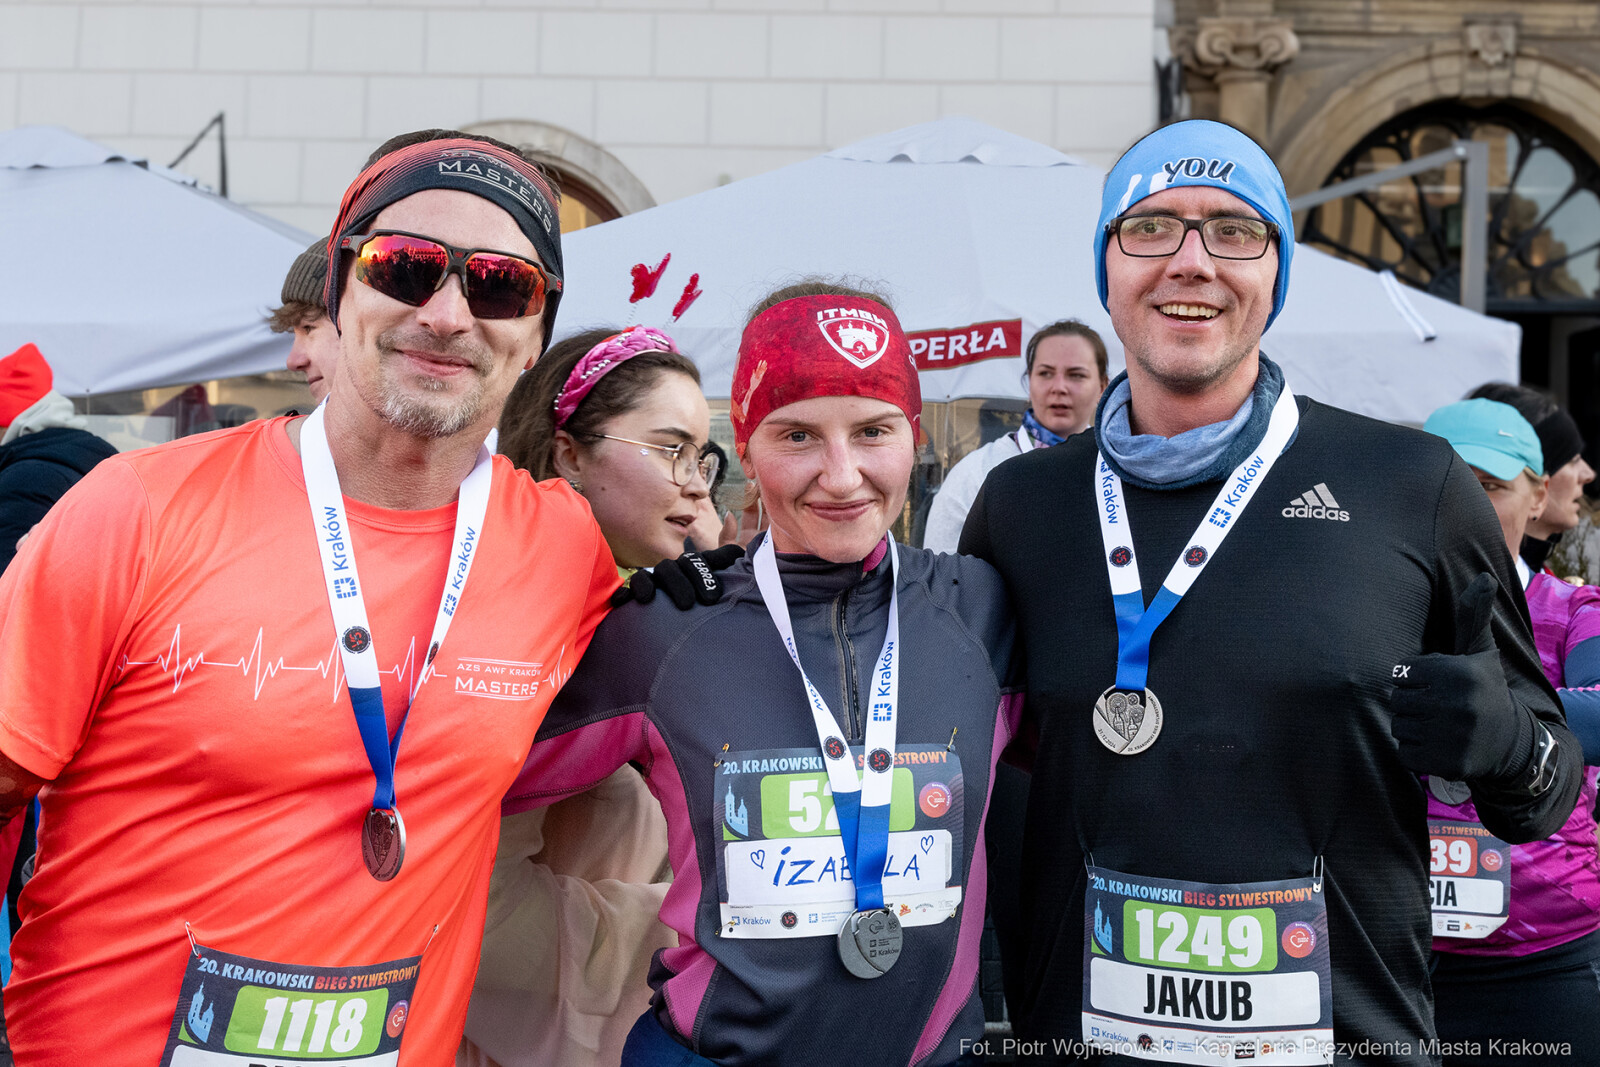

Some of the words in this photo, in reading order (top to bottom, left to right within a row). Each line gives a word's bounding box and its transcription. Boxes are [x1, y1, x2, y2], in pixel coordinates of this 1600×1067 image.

[1162, 157, 1236, 184] YOU
[438, 160, 552, 233] MASTERS
[909, 327, 1007, 361] PERŁA
[1224, 455, 1265, 508] Kraków
[1102, 475, 1118, 524] Kraków
[1282, 505, 1350, 522] adidas
[322, 506, 349, 571] Kraków
[452, 527, 476, 590] Kraków
[689, 557, 717, 590] TERREX
[457, 663, 480, 672] AZS
[485, 666, 505, 674] AWF
[877, 641, 894, 697] Kraków
[455, 676, 539, 695] MASTERS
[723, 764, 740, 775] 20.
[742, 757, 822, 773] KRAKOWSKI
[1093, 877, 1108, 890] 20.
[1108, 883, 1182, 903] KRAKOWSKI
[1184, 891, 1216, 906] BIEG
[1218, 887, 1313, 906] SYLWESTROWY
[743, 917, 771, 926] Kraków
[1136, 908, 1263, 968] 1249
[197, 957, 220, 976] 20.
[221, 963, 315, 989] KRAKOWSKI
[314, 976, 348, 990] BIEG
[349, 965, 418, 990] SYLWESTROWY
[1144, 973, 1253, 1022] JAKUB
[257, 996, 368, 1053] 1118
[1101, 1030, 1129, 1042] Kraków
